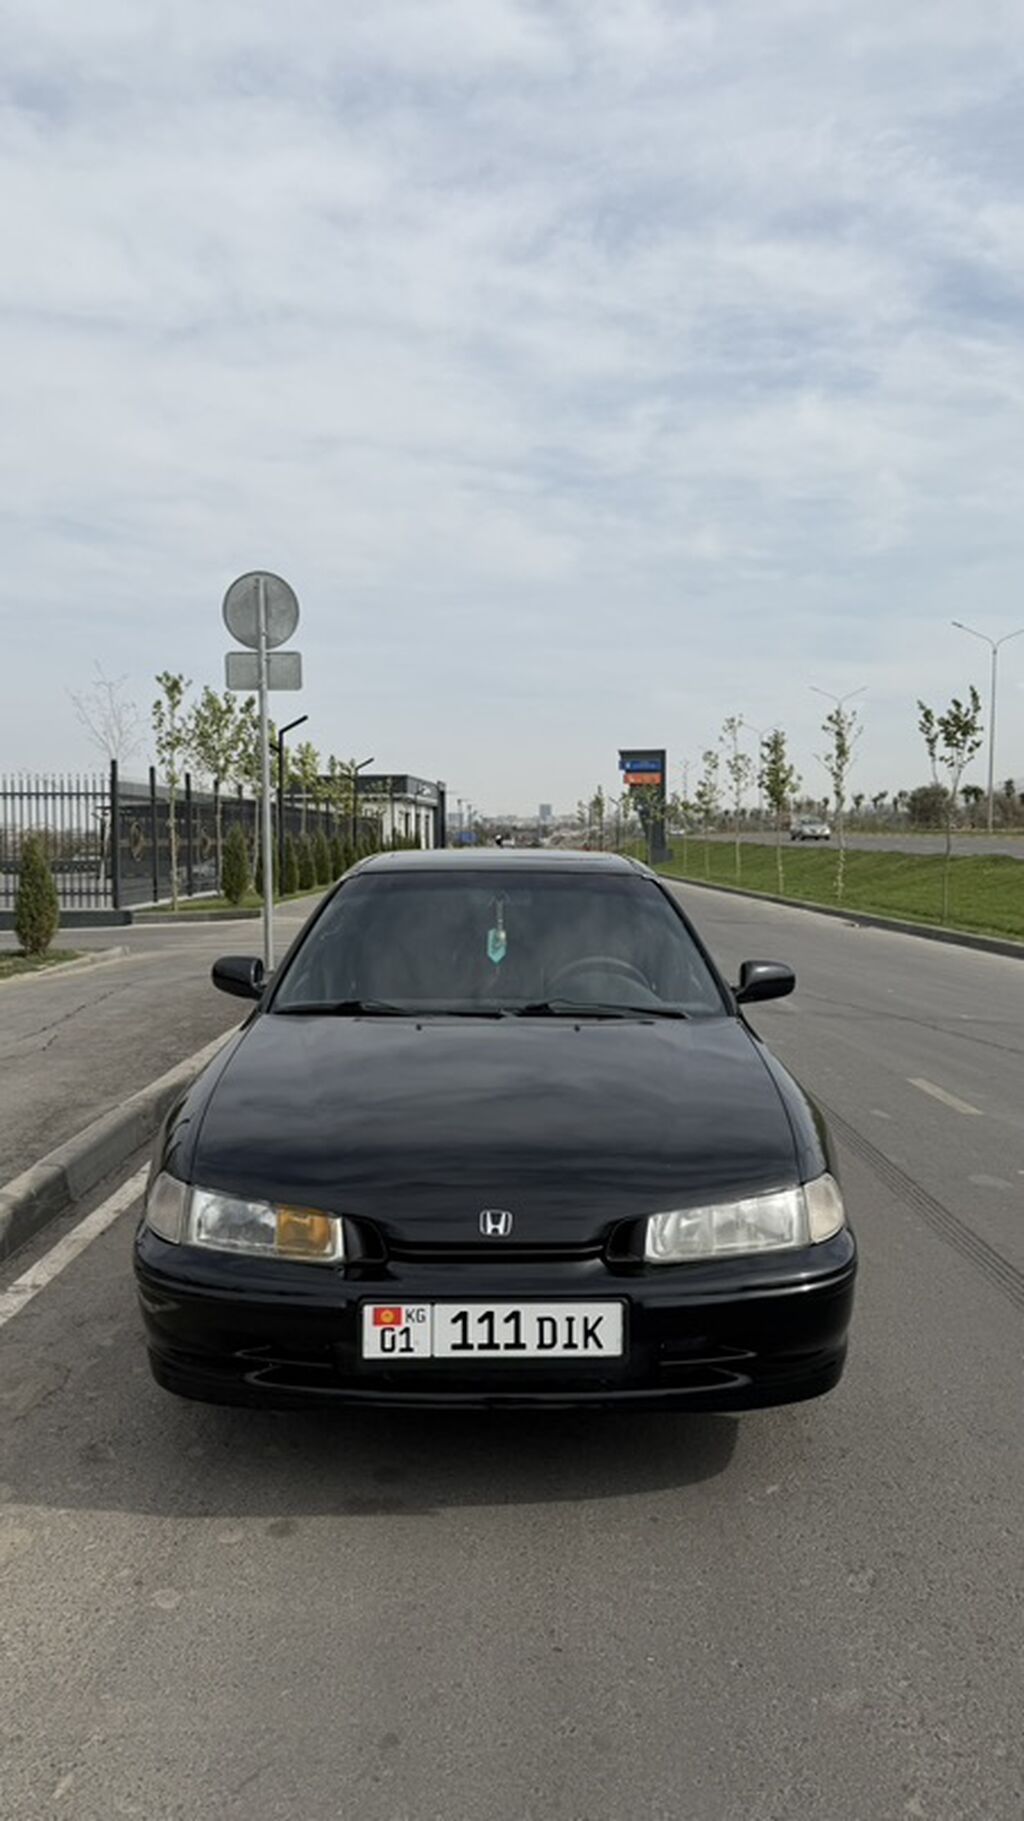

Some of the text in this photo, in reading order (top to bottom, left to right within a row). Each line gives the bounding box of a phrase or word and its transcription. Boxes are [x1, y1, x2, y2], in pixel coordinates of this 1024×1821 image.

[405, 1308, 426, 1323] KG
[379, 1327, 414, 1353] 01
[450, 1310, 604, 1351] 111 DIK
